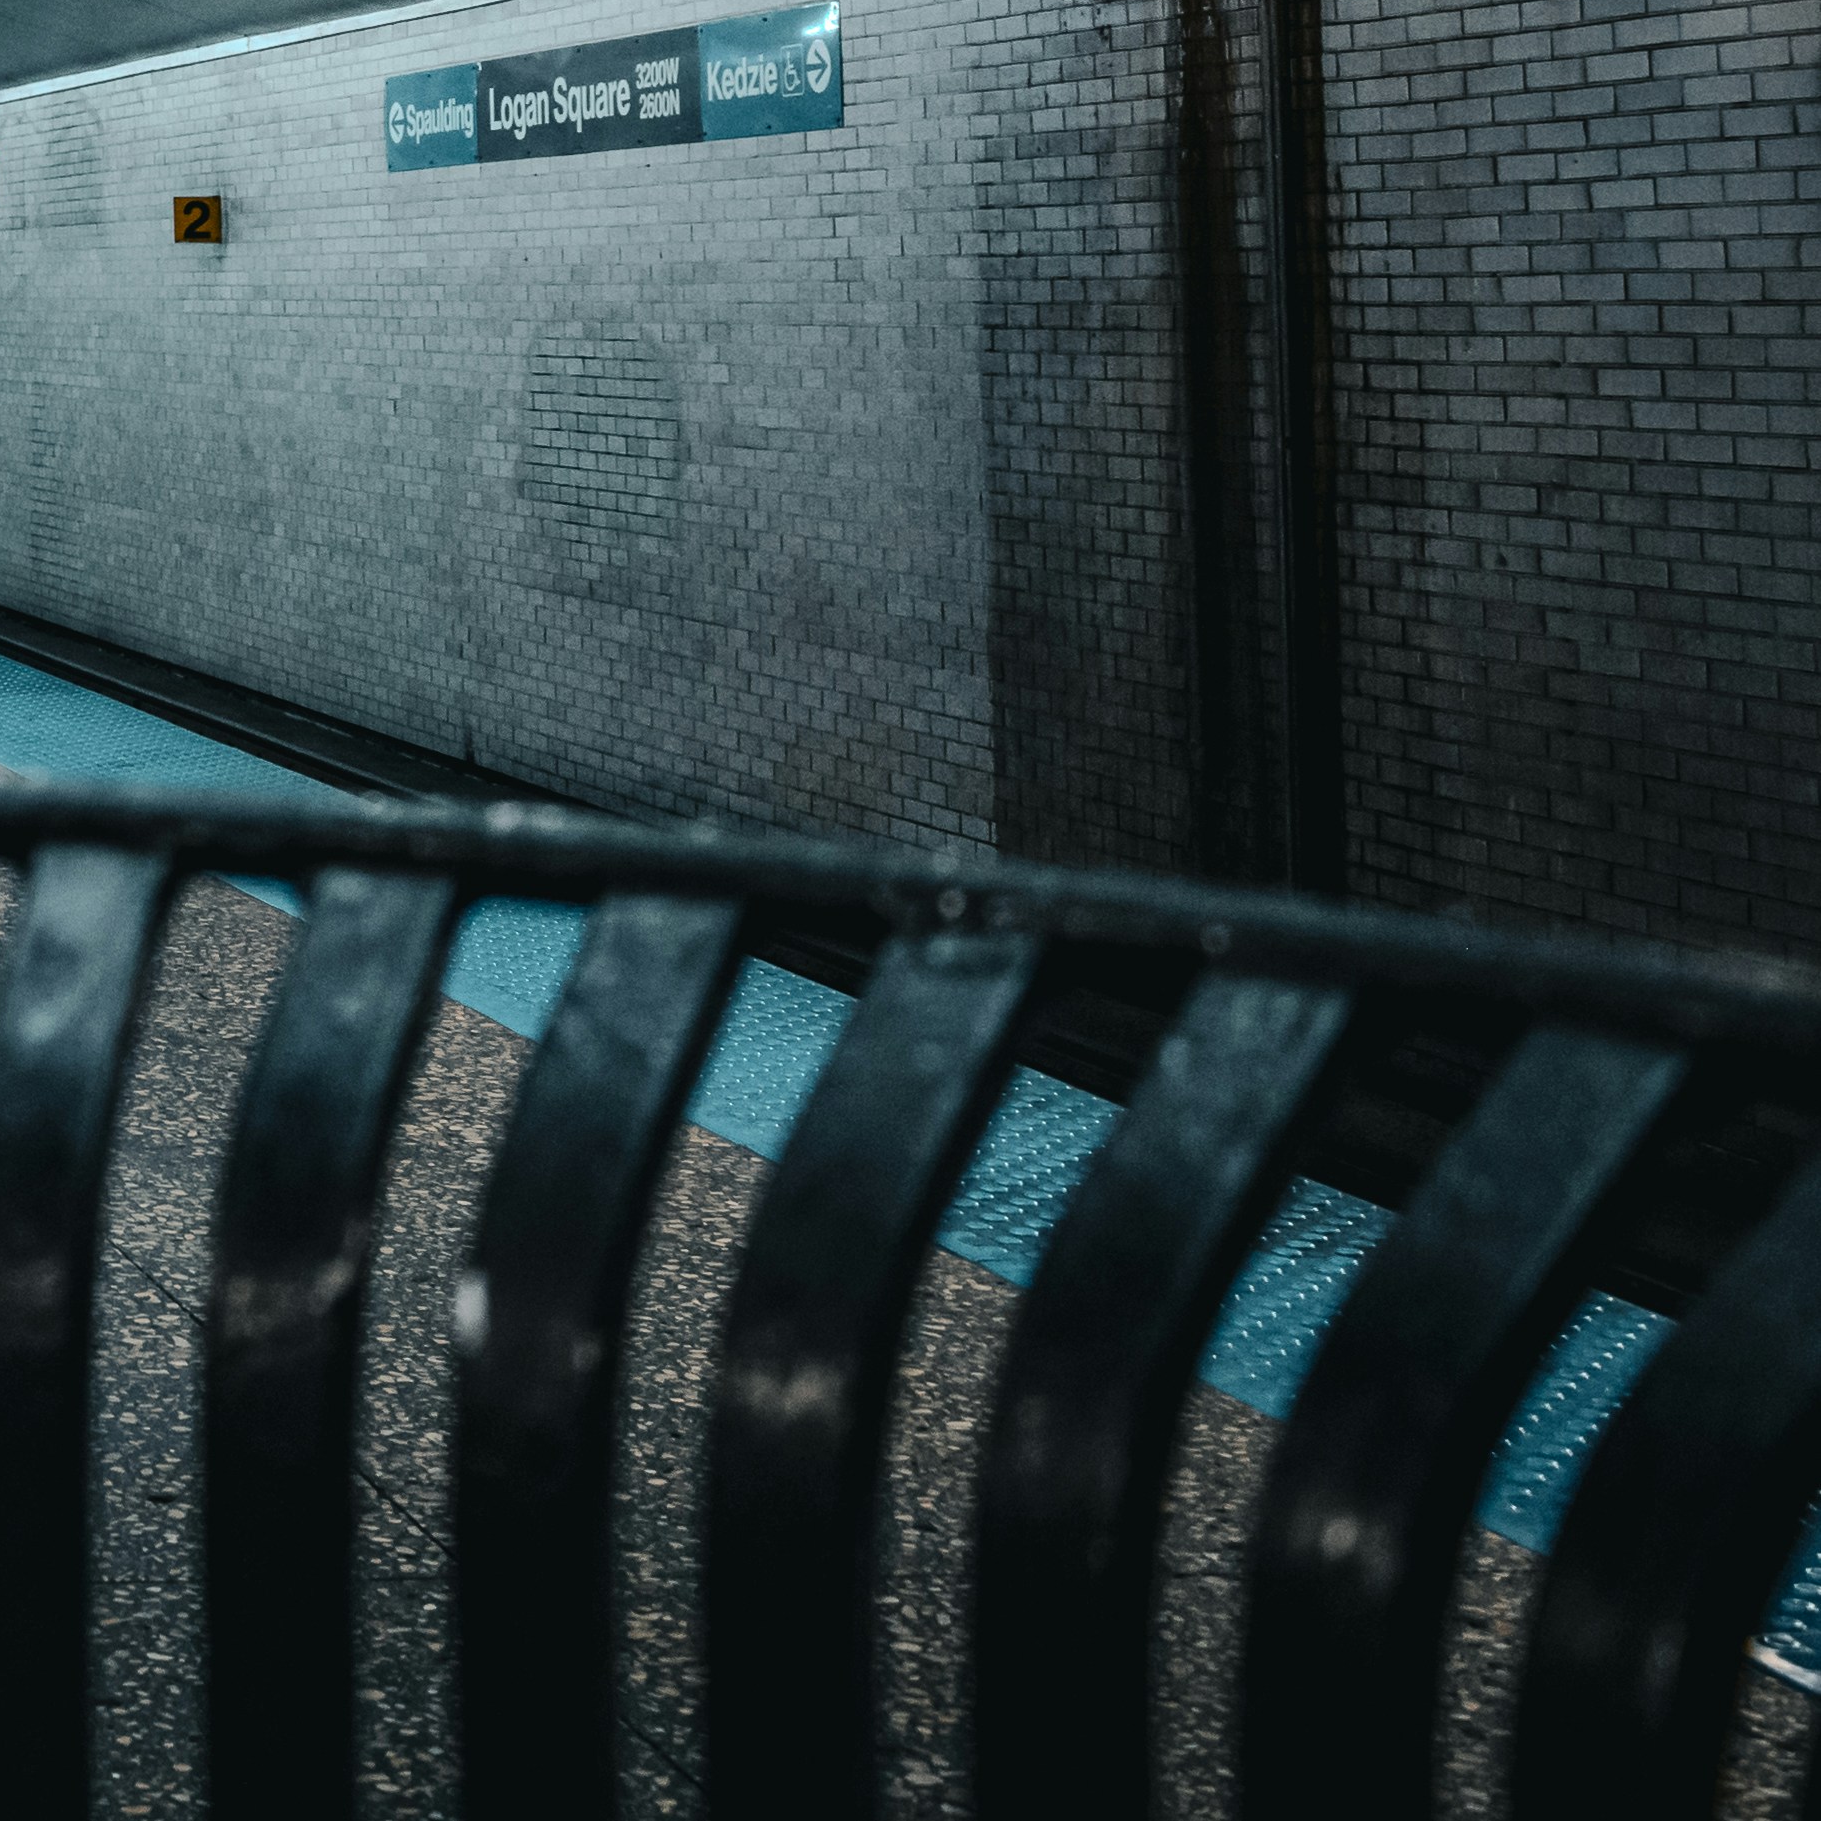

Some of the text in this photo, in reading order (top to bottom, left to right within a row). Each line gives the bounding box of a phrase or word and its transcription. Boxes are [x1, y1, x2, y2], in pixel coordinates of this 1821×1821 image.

[635, 57, 680, 88] 3200W
[707, 54, 777, 102] Kedzie
[406, 99, 474, 144] Spaulding
[489, 76, 630, 140] Logan Square
[639, 90, 680, 119] 2600N
[183, 200, 212, 239] 2
